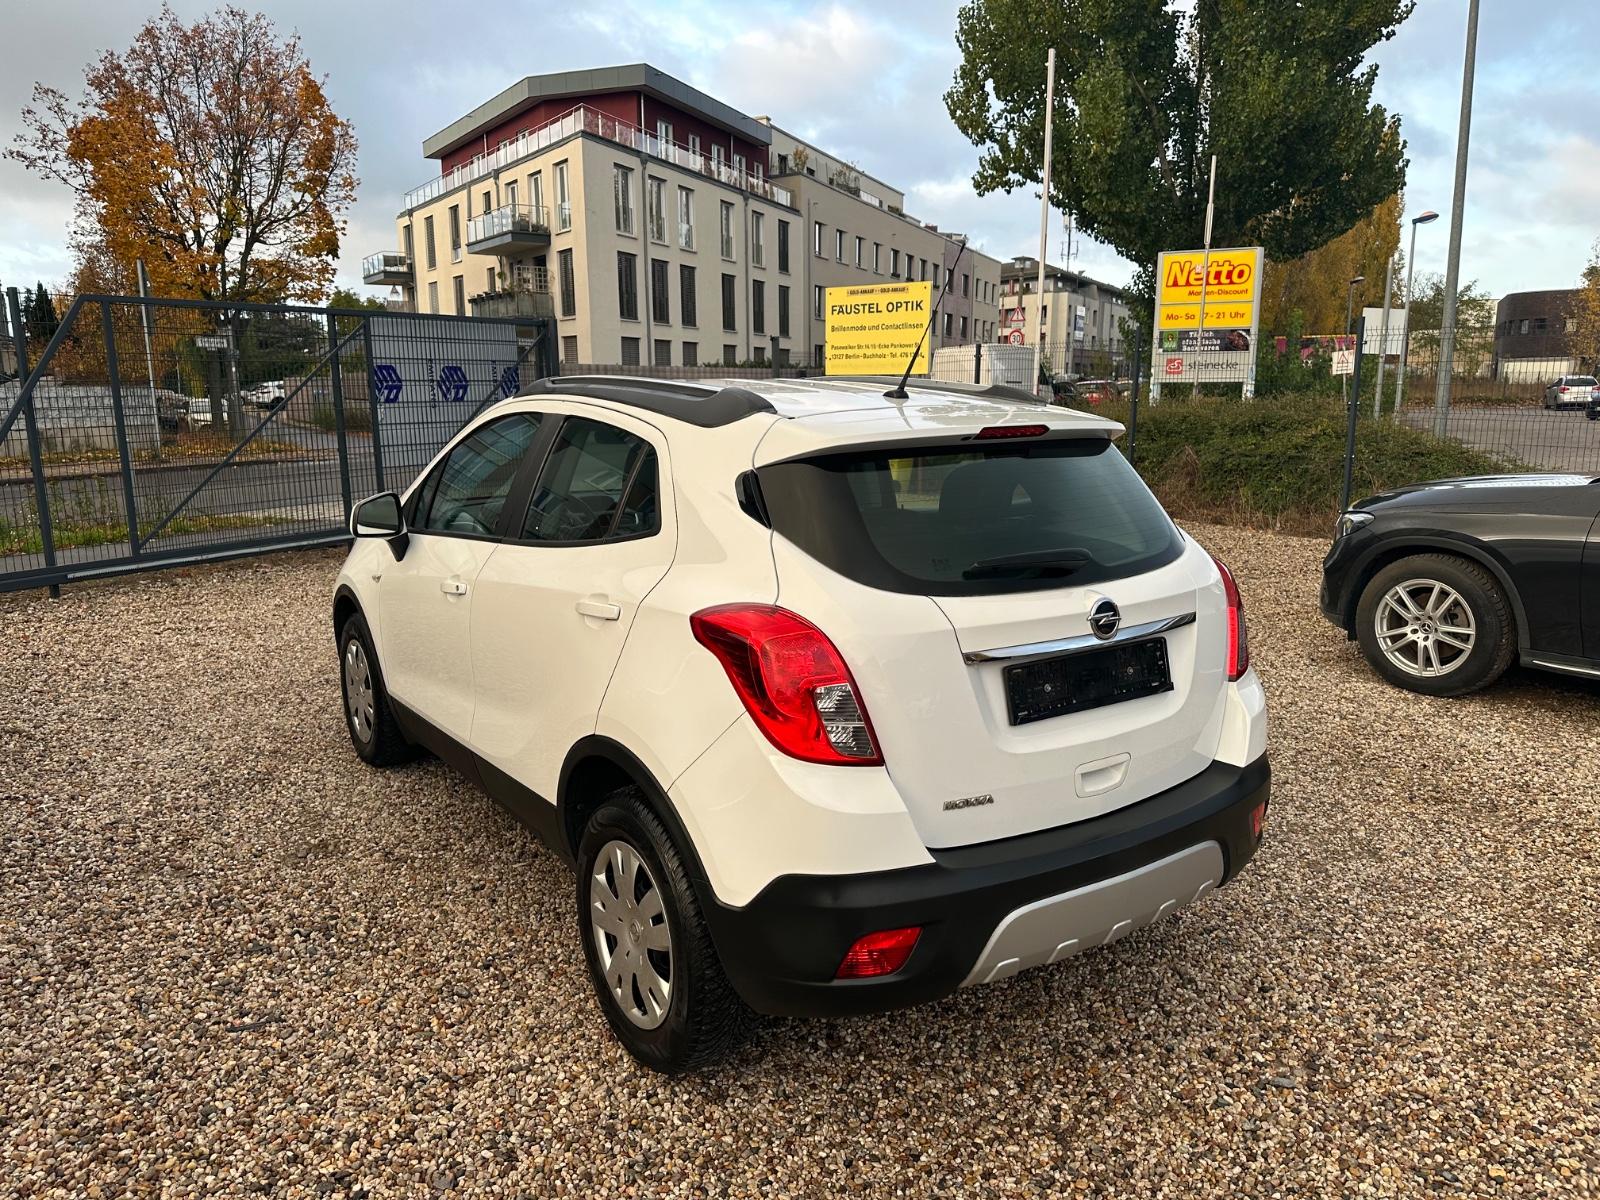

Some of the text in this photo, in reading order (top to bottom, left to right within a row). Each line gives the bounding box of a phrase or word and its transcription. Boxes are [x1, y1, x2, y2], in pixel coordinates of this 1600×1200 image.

[1166, 260, 1252, 288] Netto
[831, 300, 924, 315] FÄUSTEL OPTIK
[1229, 311, 1246, 319] Uhr
[881, 322, 924, 331] Contactlinsen
[1012, 335, 1020, 343] 30
